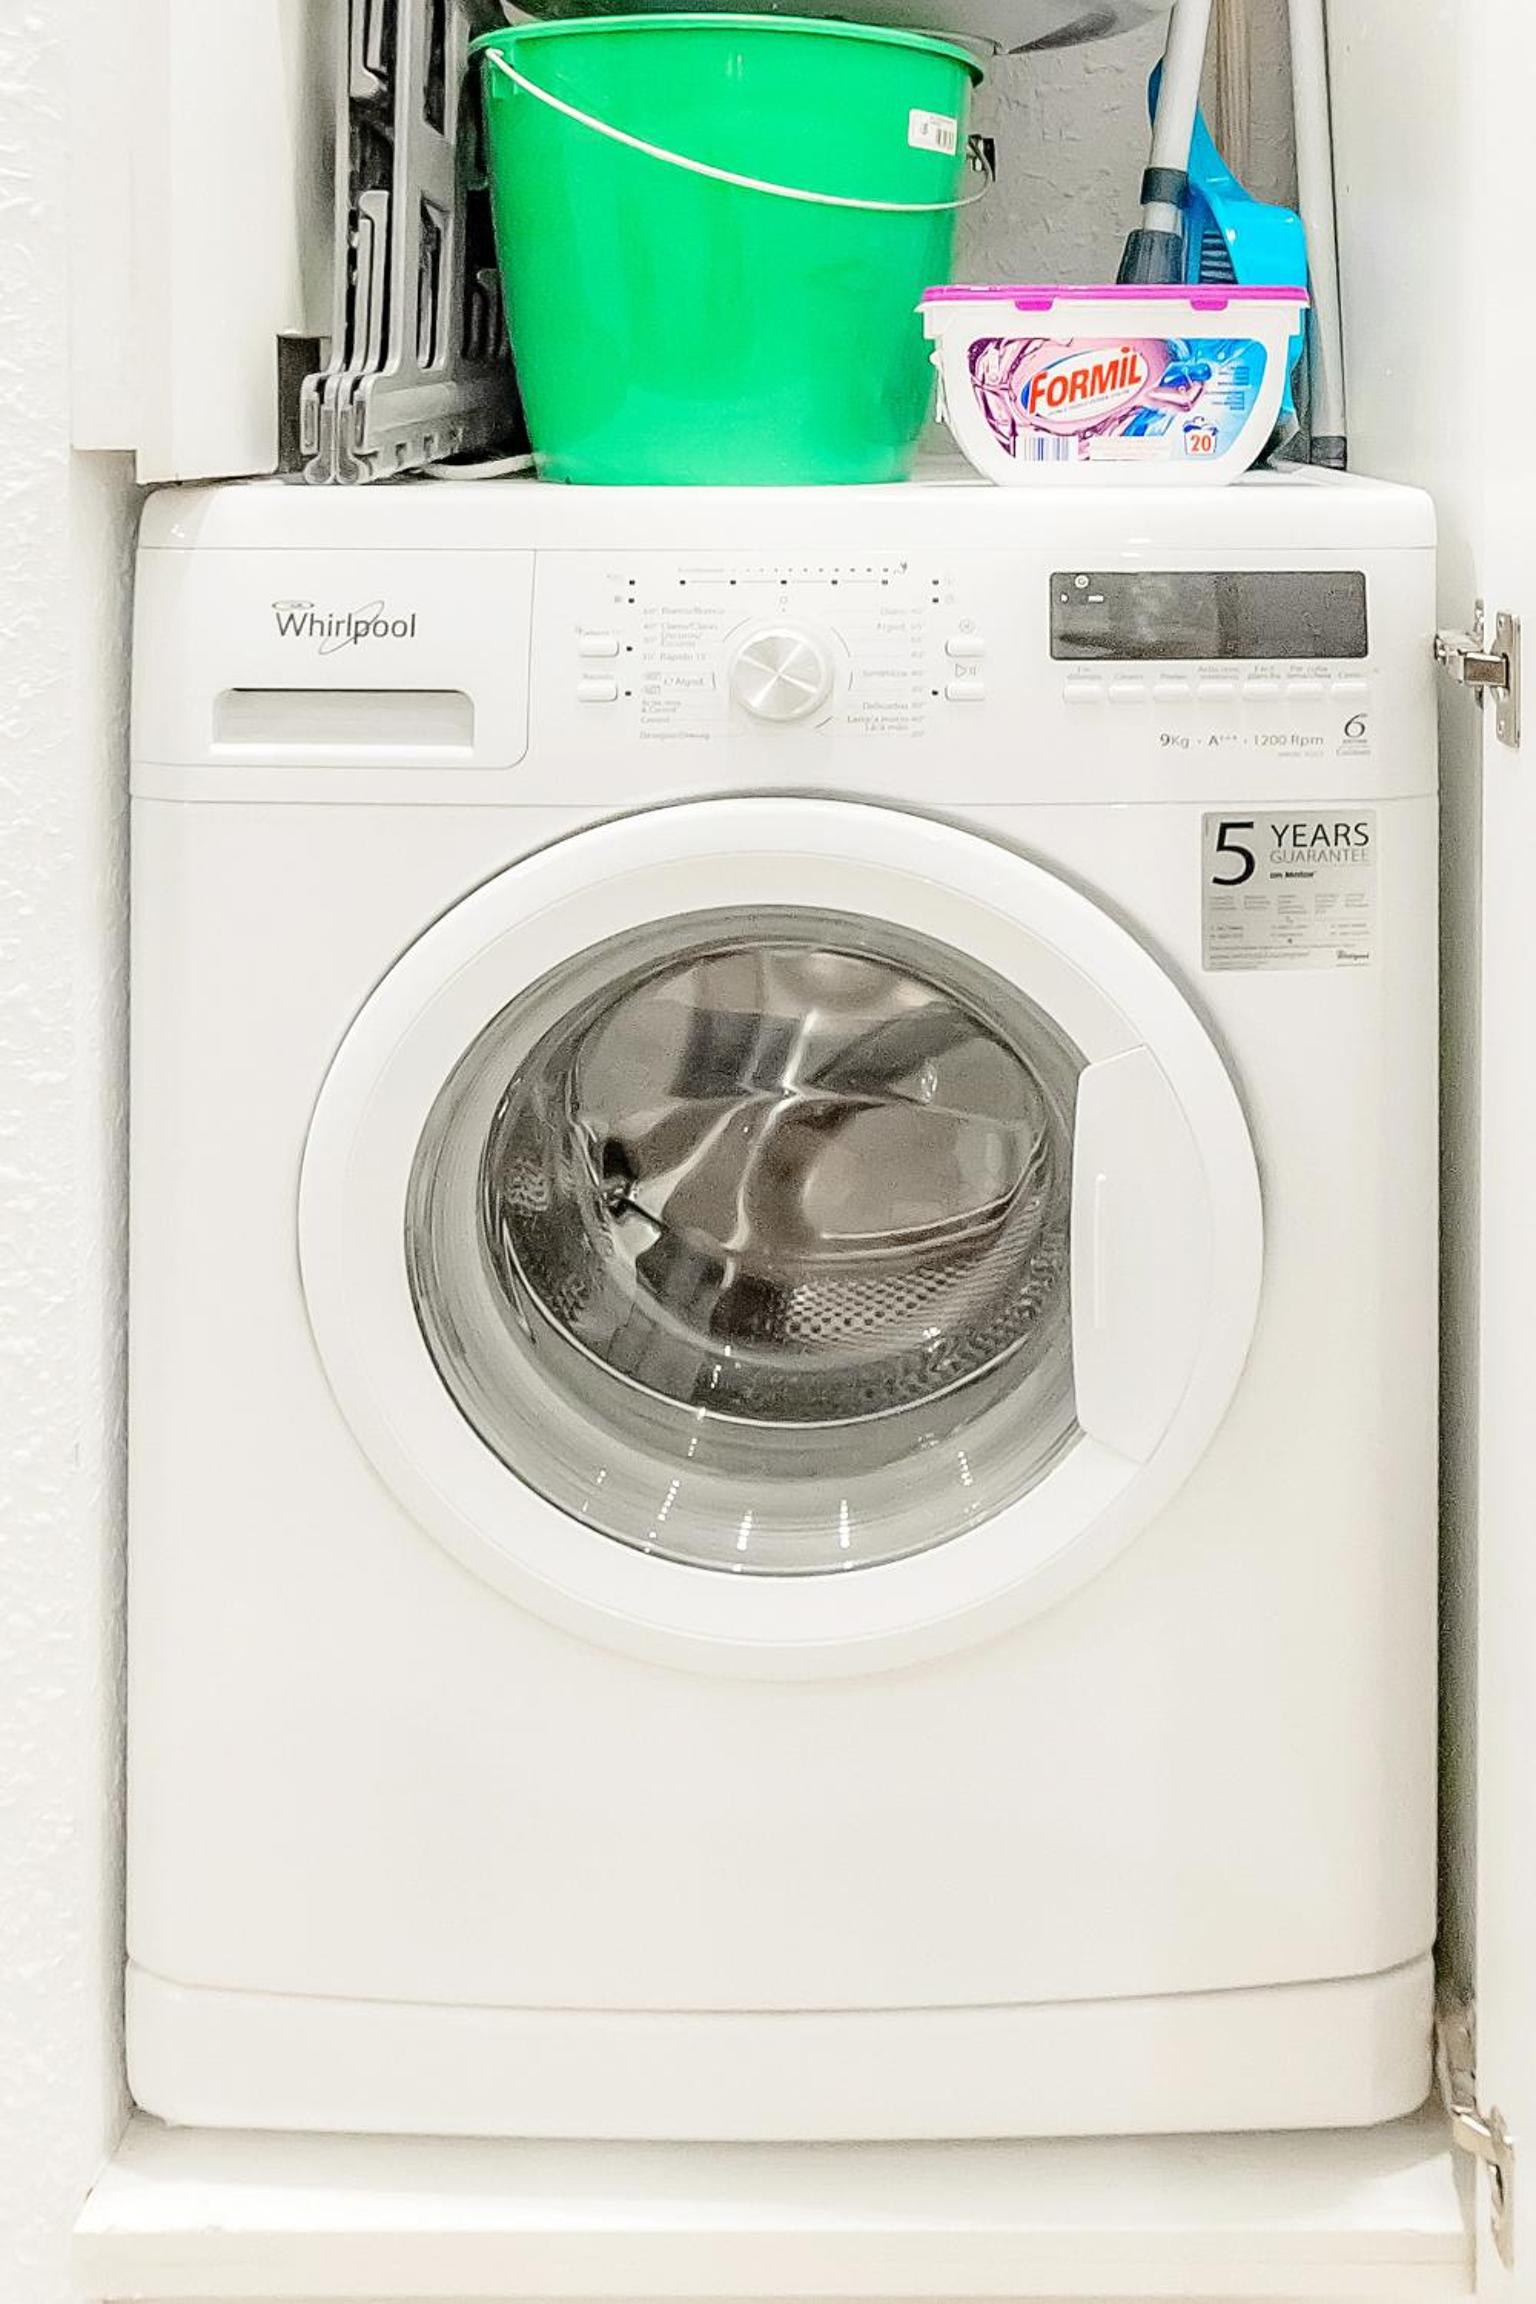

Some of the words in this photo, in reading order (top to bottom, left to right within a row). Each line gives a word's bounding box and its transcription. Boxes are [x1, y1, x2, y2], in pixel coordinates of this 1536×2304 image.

[1029, 346, 1142, 414] FORMIL
[1190, 434, 1212, 452] 20
[275, 613, 416, 645] Whirlpool
[1159, 733, 1190, 749] 9Kg
[1253, 735, 1288, 746] 1200
[1270, 822, 1370, 848] YEARS
[1212, 821, 1256, 886] 5
[1269, 848, 1369, 863] GUARANTEE
